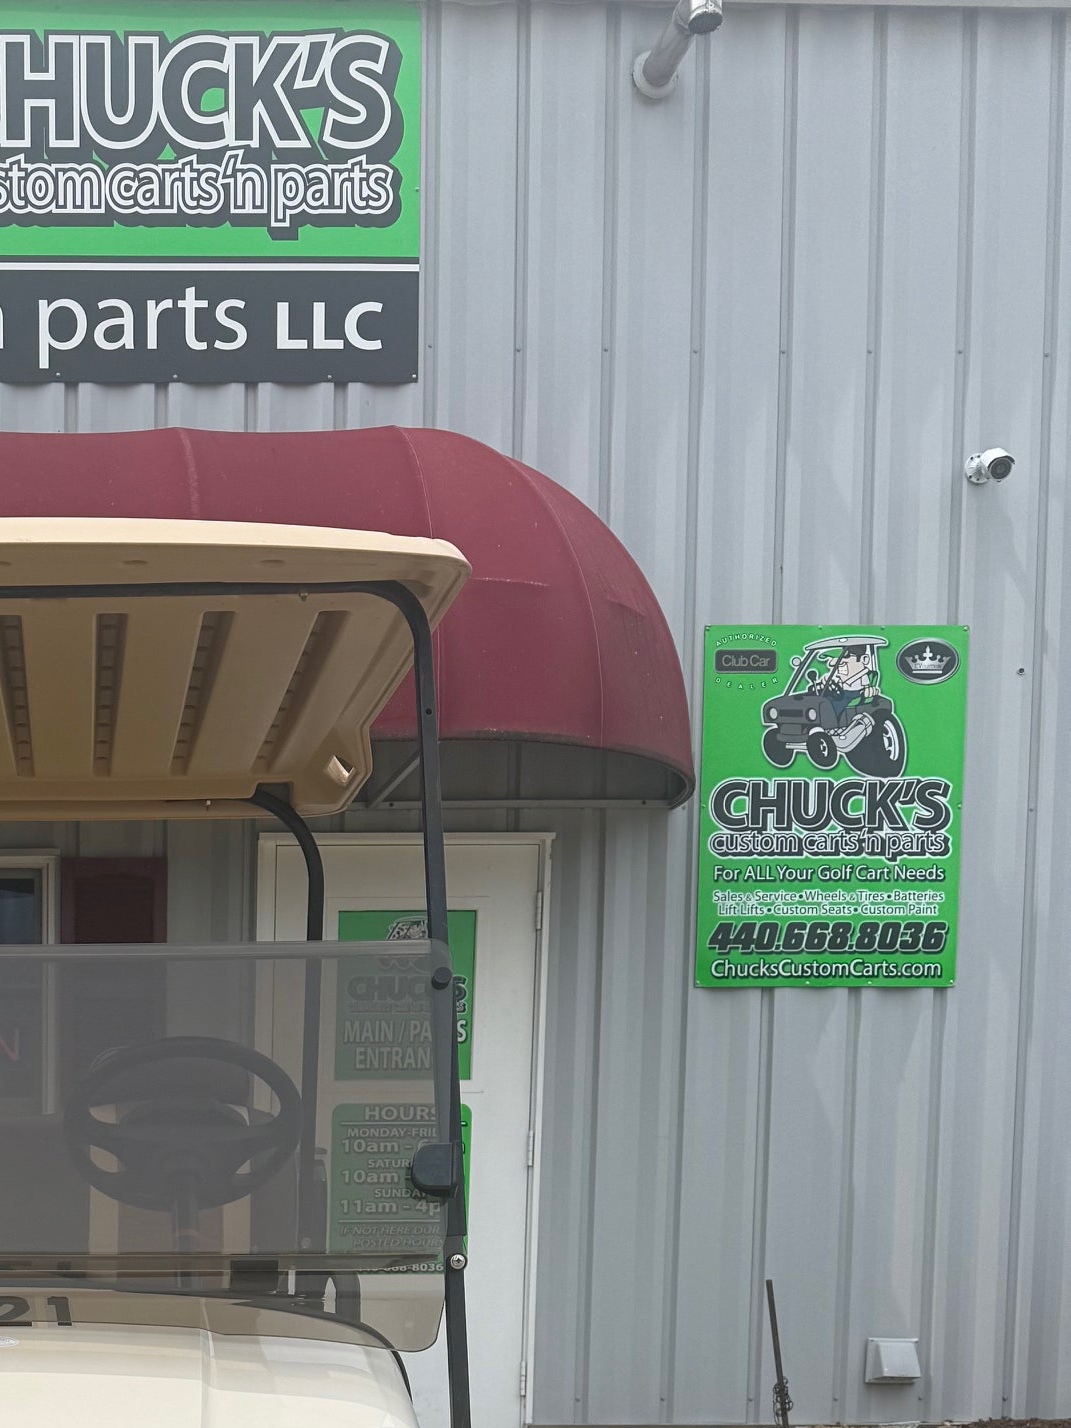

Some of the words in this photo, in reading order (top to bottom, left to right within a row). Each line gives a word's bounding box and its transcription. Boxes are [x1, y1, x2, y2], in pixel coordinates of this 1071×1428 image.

[270, 155, 394, 226] parts
[39, 286, 248, 369] parts
[275, 301, 383, 351] LLC
[715, 633, 778, 648] AUTHORIZED
[721, 654, 749, 667] Club
[749, 654, 770, 667] Car
[715, 677, 778, 690] DEALER
[711, 778, 950, 831] CHUCK'S
[711, 831, 798, 853] custom
[885, 831, 945, 857] parts
[714, 866, 740, 880] For
[744, 866, 774, 880] ALL
[777, 866, 813, 880] Your
[818, 865, 852, 880] Golf
[856, 866, 889, 880] Cart
[894, 865, 945, 880] Needs
[713, 890, 743, 902] Sales
[755, 890, 797, 902] Service
[805, 890, 847, 902] Wheels
[857, 890, 885, 902] Tires
[893, 890, 944, 902] Batteries
[718, 904, 738, 915] Lift
[740, 904, 765, 915] Lifts
[773, 904, 820, 915] Custom
[822, 904, 853, 915] Seats
[860, 904, 906, 915] Custom
[908, 904, 938, 915] Paint
[708, 921, 948, 952] 440.668.8036
[711, 959, 942, 977] ChucksCustomCarts.com
[344, 1020, 393, 1043] MAIN
[355, 1047, 432, 1070] ENTRAN
[347, 1128, 437, 1137] MONDAY-FRI
[342, 1139, 399, 1153] 10am
[368, 1158, 412, 1168] SATUR
[342, 1170, 398, 1183] 10am
[341, 1200, 398, 1213] 11am
[415, 1201, 441, 1215] 4p
